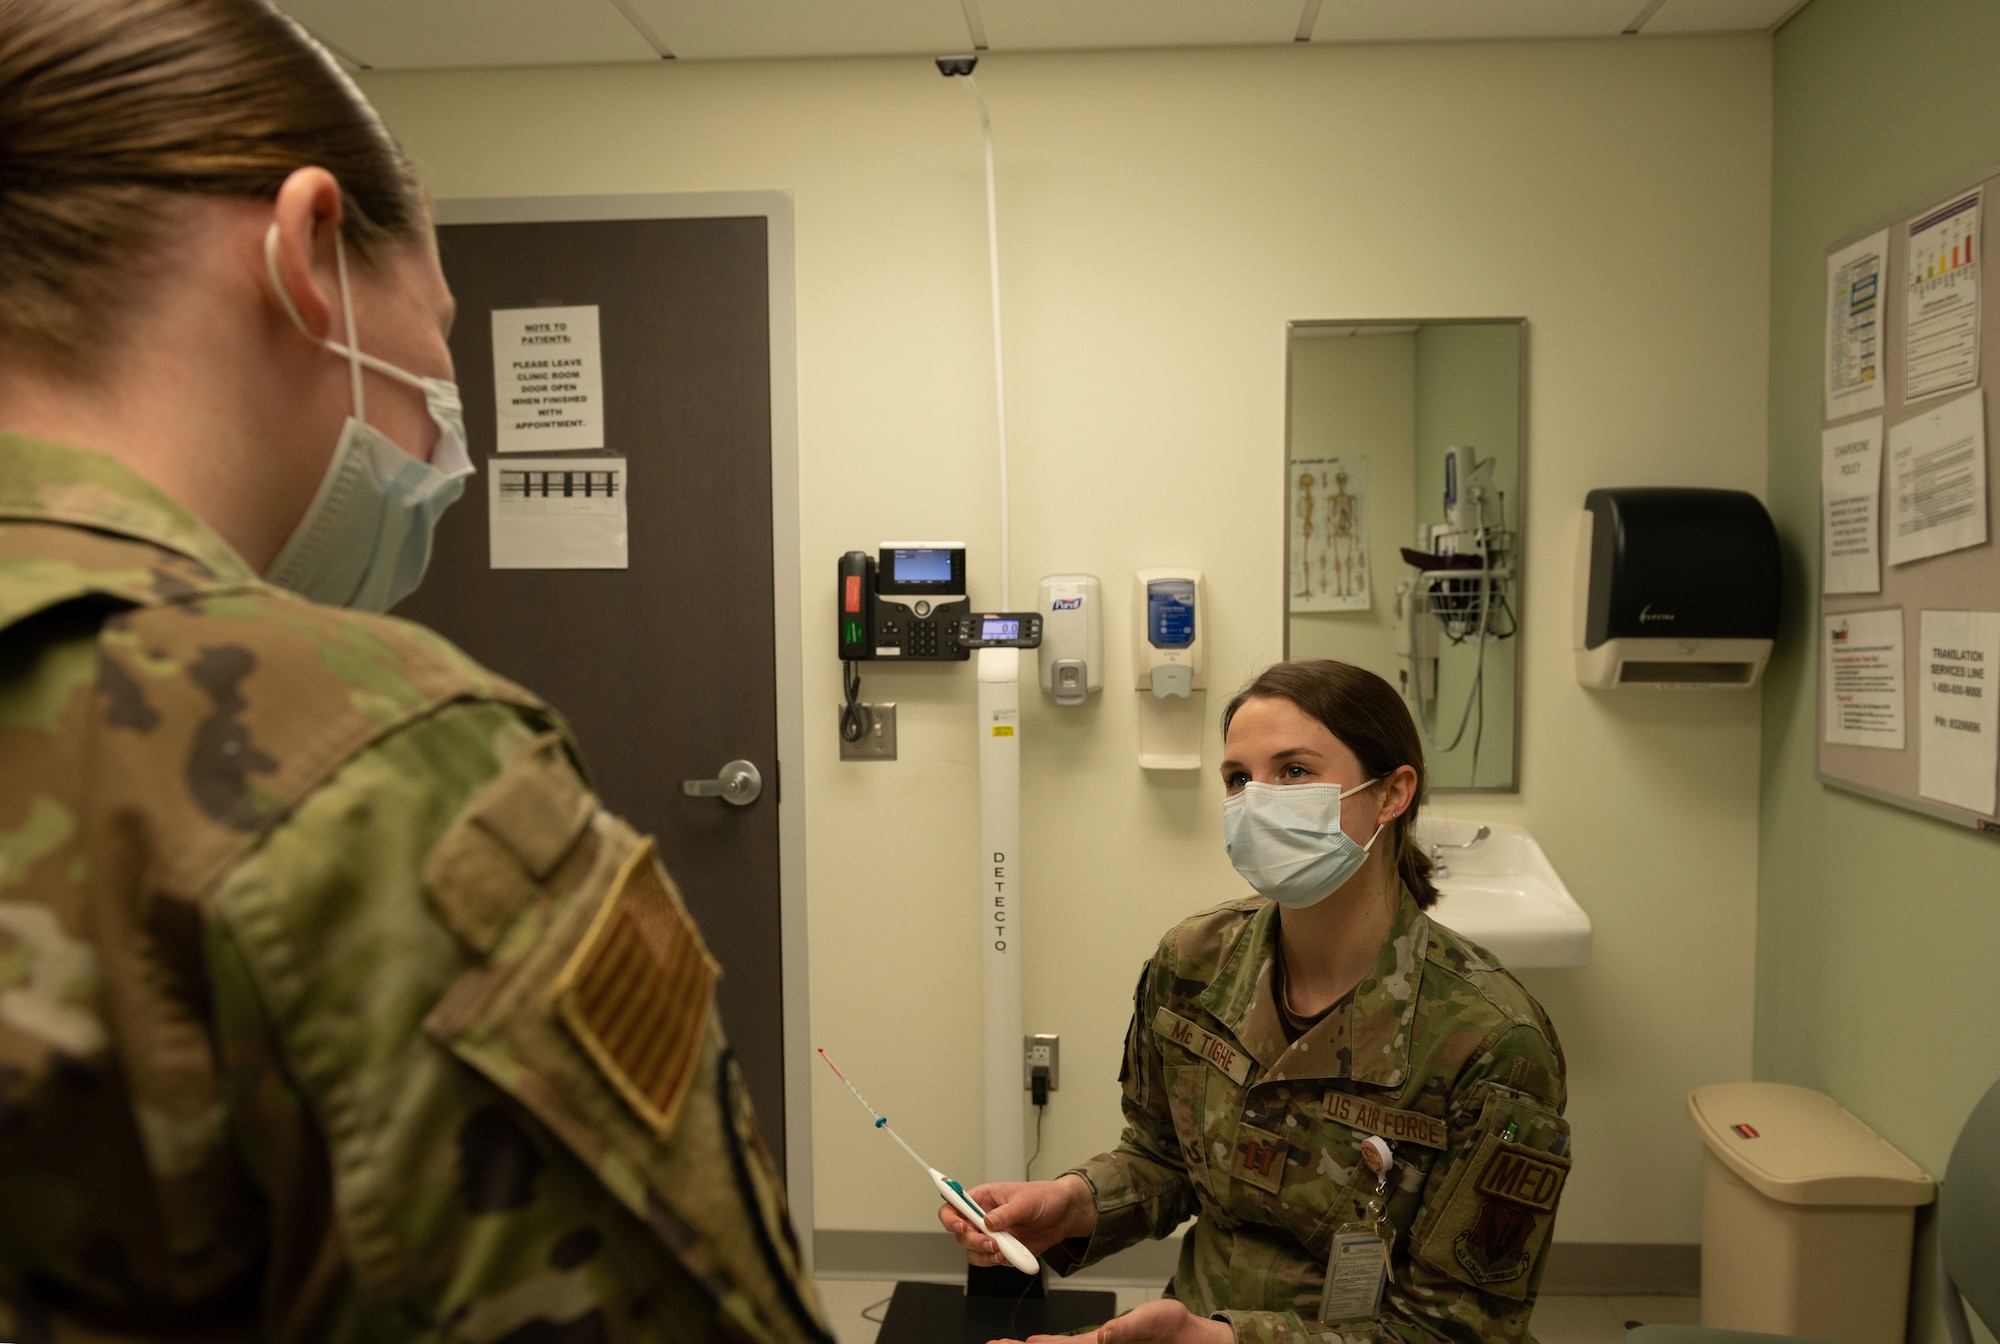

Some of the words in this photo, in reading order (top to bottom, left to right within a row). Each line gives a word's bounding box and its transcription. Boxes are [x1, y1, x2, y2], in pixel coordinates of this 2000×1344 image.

[525, 324, 550, 332] NOTE
[553, 323, 567, 331] TO
[521, 335, 571, 344] PATIENTS:
[512, 360, 548, 369] PLEASE
[551, 359, 582, 367] LEAVE
[516, 373, 548, 381] CLINIC
[551, 371, 580, 379] ROOM
[521, 385, 548, 393] DOOR
[550, 384, 577, 392] OPEN
[543, 396, 587, 404] FINISHED
[515, 420, 586, 429] APPOINTMENT.
[1835, 439, 1870, 458] CHAPERONE
[1840, 461, 1861, 476] POLICY
[1002, 623, 1018, 633] 0.0
[1932, 647, 1984, 662] TRANSLATION
[1931, 663, 1966, 678] SERVICES
[1967, 667, 1985, 679] LINE
[993, 852, 1006, 951] DETECTO
[1171, 1020, 1193, 1045] Mc
[1200, 1033, 1236, 1072] TIGHE
[1327, 1094, 1351, 1121] U.S.
[1355, 1104, 1380, 1131] AIR
[1384, 1112, 1439, 1144] FORCE
[1486, 1154, 1558, 1204] MED
[1456, 1249, 1467, 1260] AIR
[1486, 1269, 1519, 1280] COMMAND
